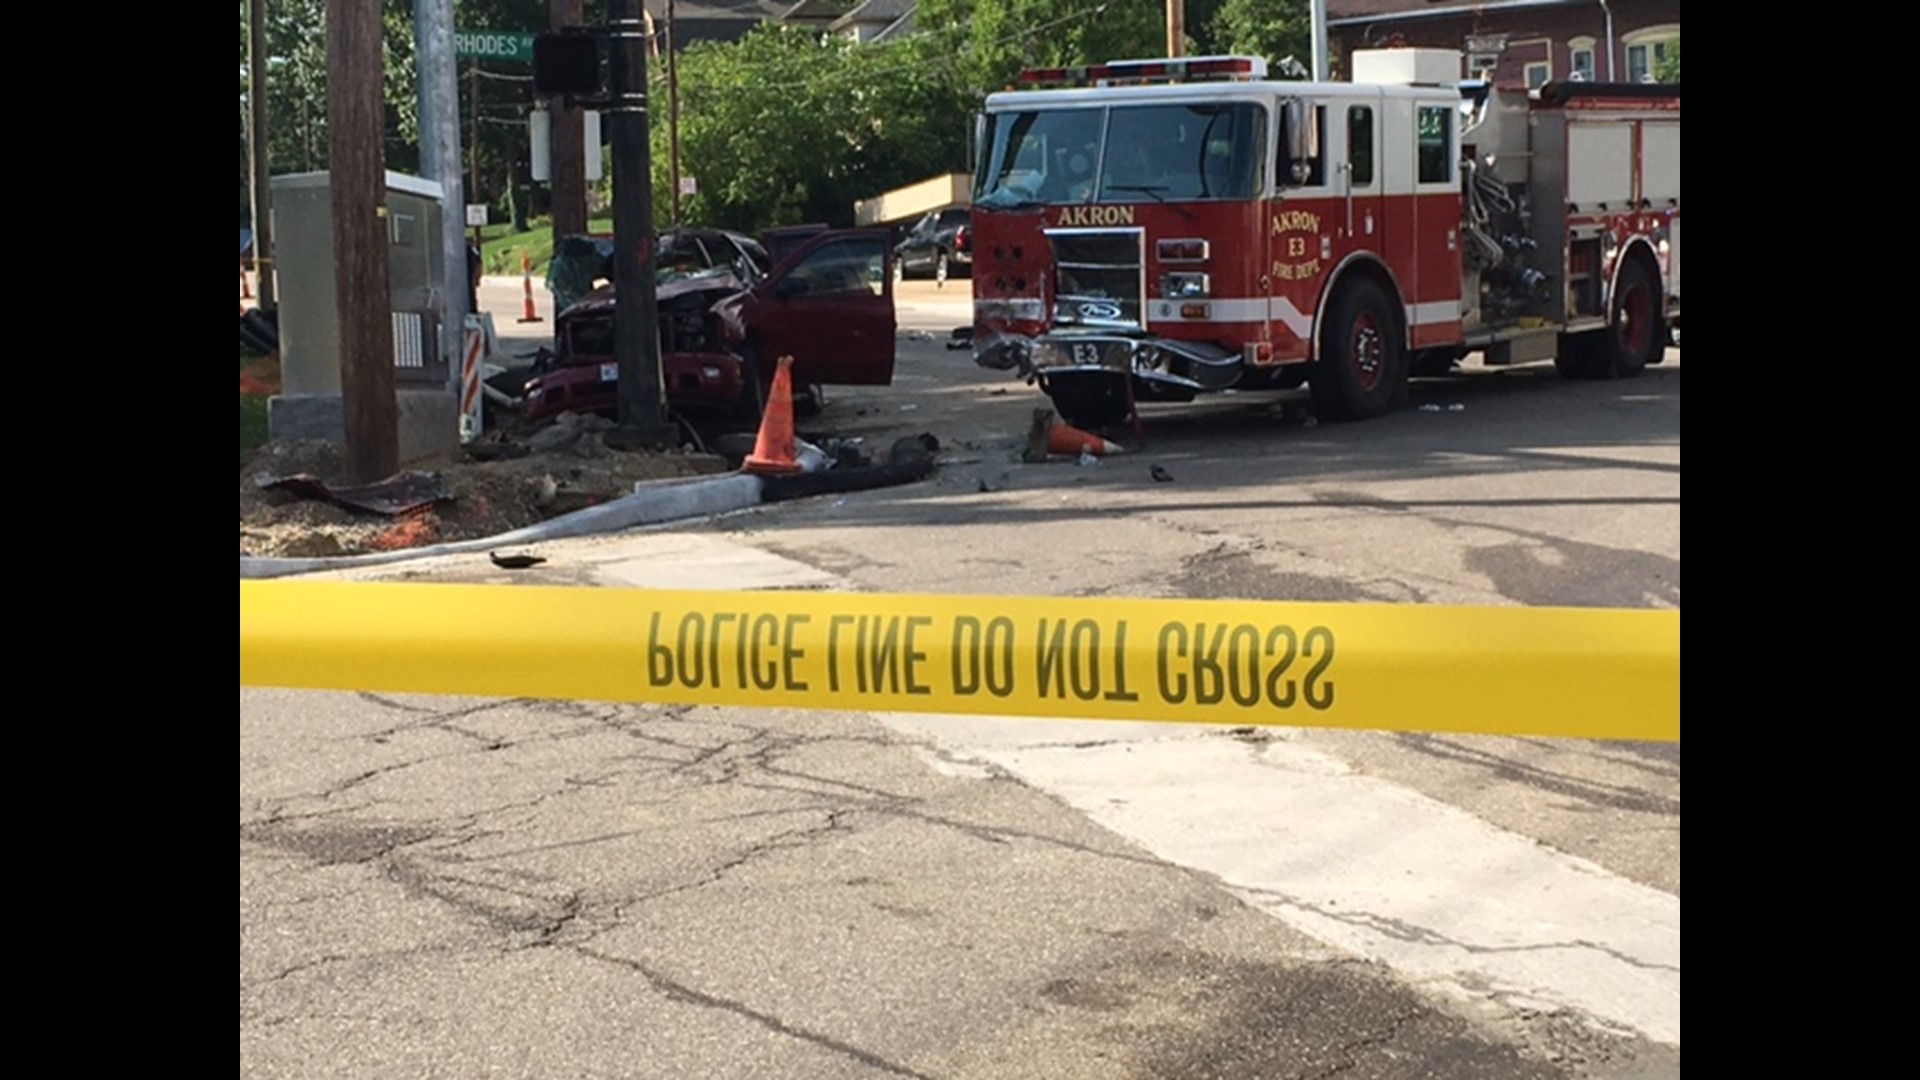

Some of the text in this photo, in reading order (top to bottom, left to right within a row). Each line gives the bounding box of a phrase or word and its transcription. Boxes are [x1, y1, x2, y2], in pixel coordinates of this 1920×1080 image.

[454, 34, 518, 55] RHODES
[1057, 205, 1135, 226] AKRON
[1271, 210, 1320, 237] AKRON
[1288, 237, 1305, 257] E3
[1272, 260, 1293, 280] FIRE
[1072, 343, 1100, 364] E3
